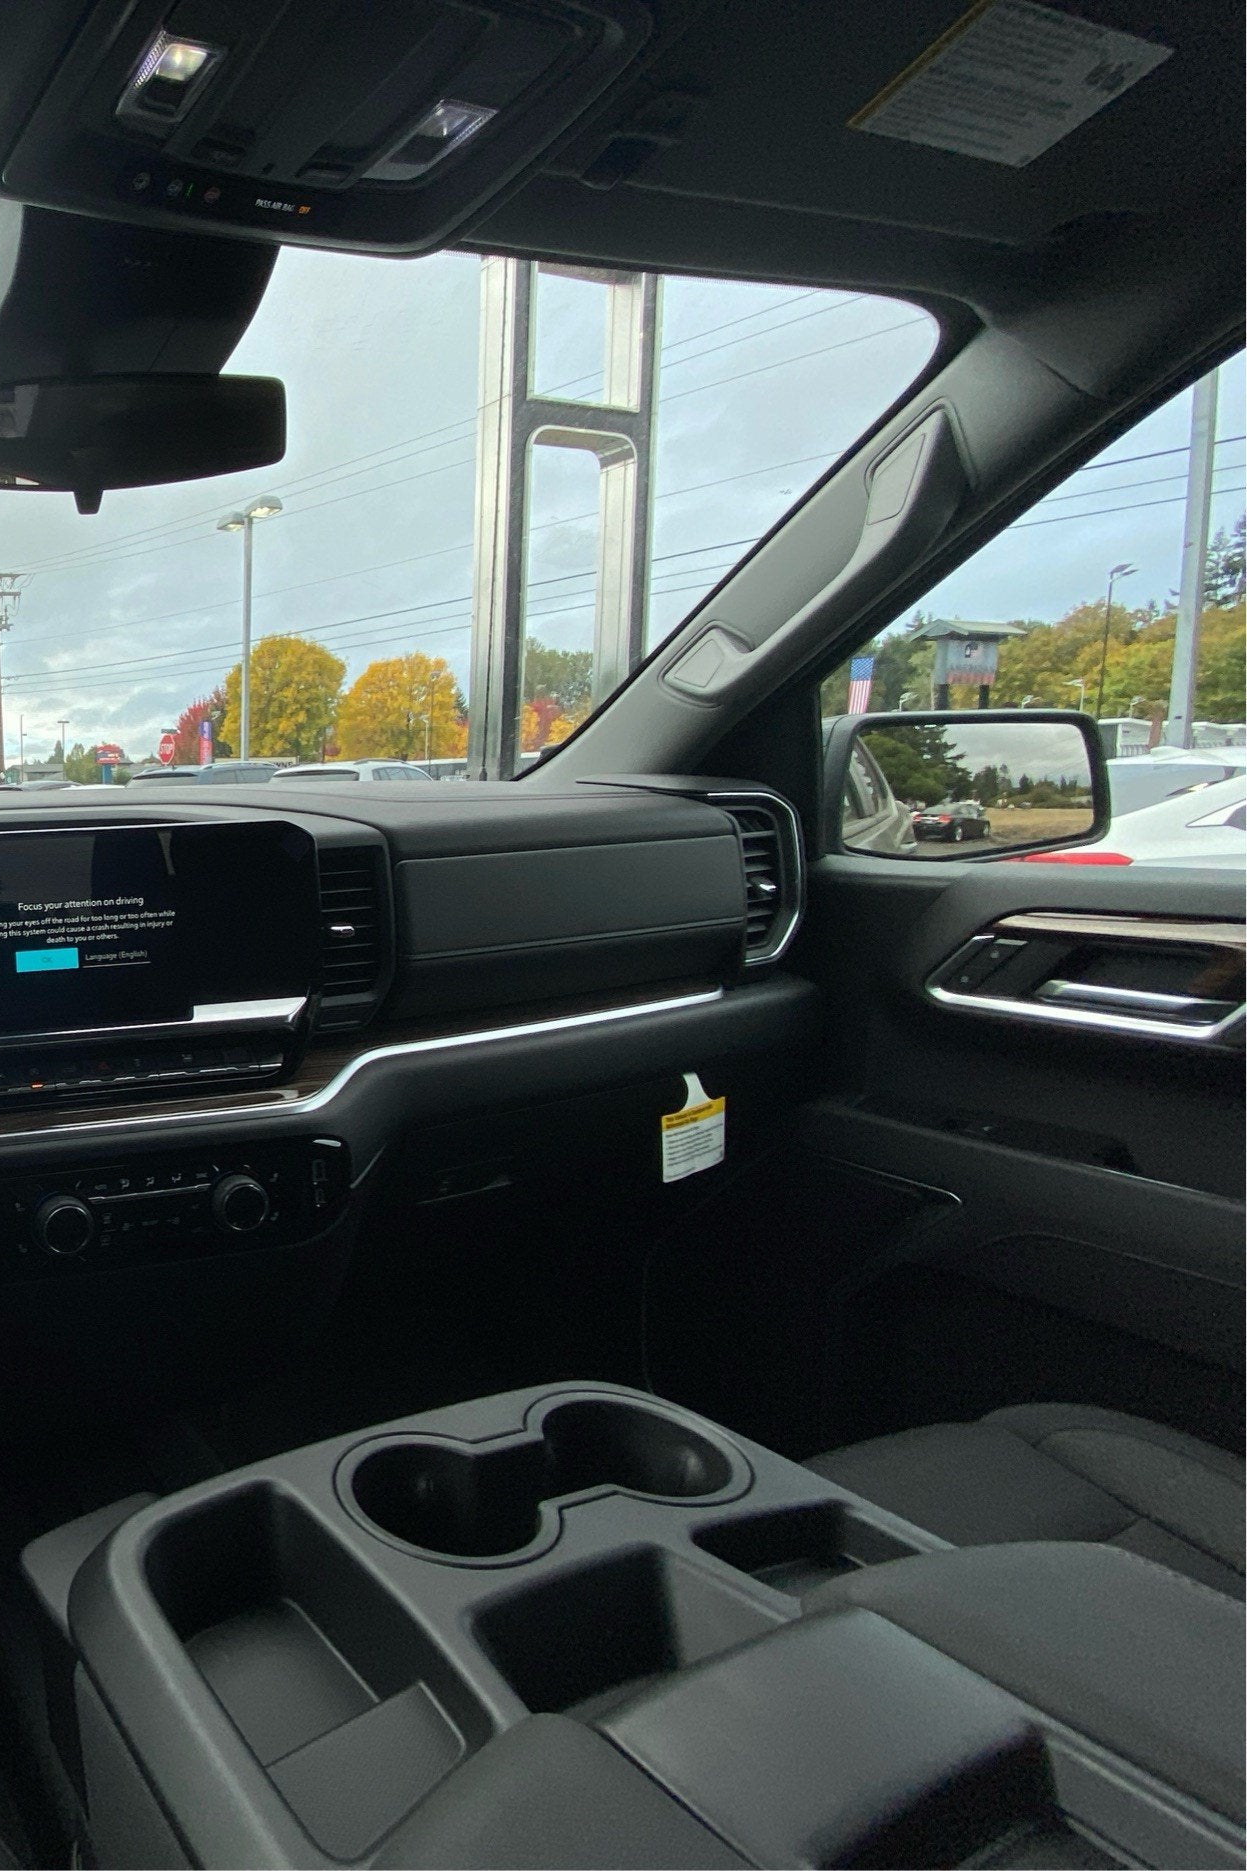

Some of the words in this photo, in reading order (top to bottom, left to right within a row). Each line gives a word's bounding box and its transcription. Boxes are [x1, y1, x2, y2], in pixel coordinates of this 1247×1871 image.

[17, 902, 43, 911] Focus
[44, 902, 62, 912] your
[64, 899, 102, 908] attention
[115, 896, 144, 906] driving
[8, 920, 23, 929] your
[24, 919, 40, 928] eyes
[41, 917, 51, 925] off
[103, 914, 119, 922] long
[22, 929, 46, 937] system
[46, 926, 65, 934] could
[92, 923, 109, 931] crash
[110, 922, 139, 930] resulting
[146, 920, 165, 929] injury
[46, 936, 66, 944] death
[85, 953, 117, 961] Language
[118, 950, 148, 959] (English)
